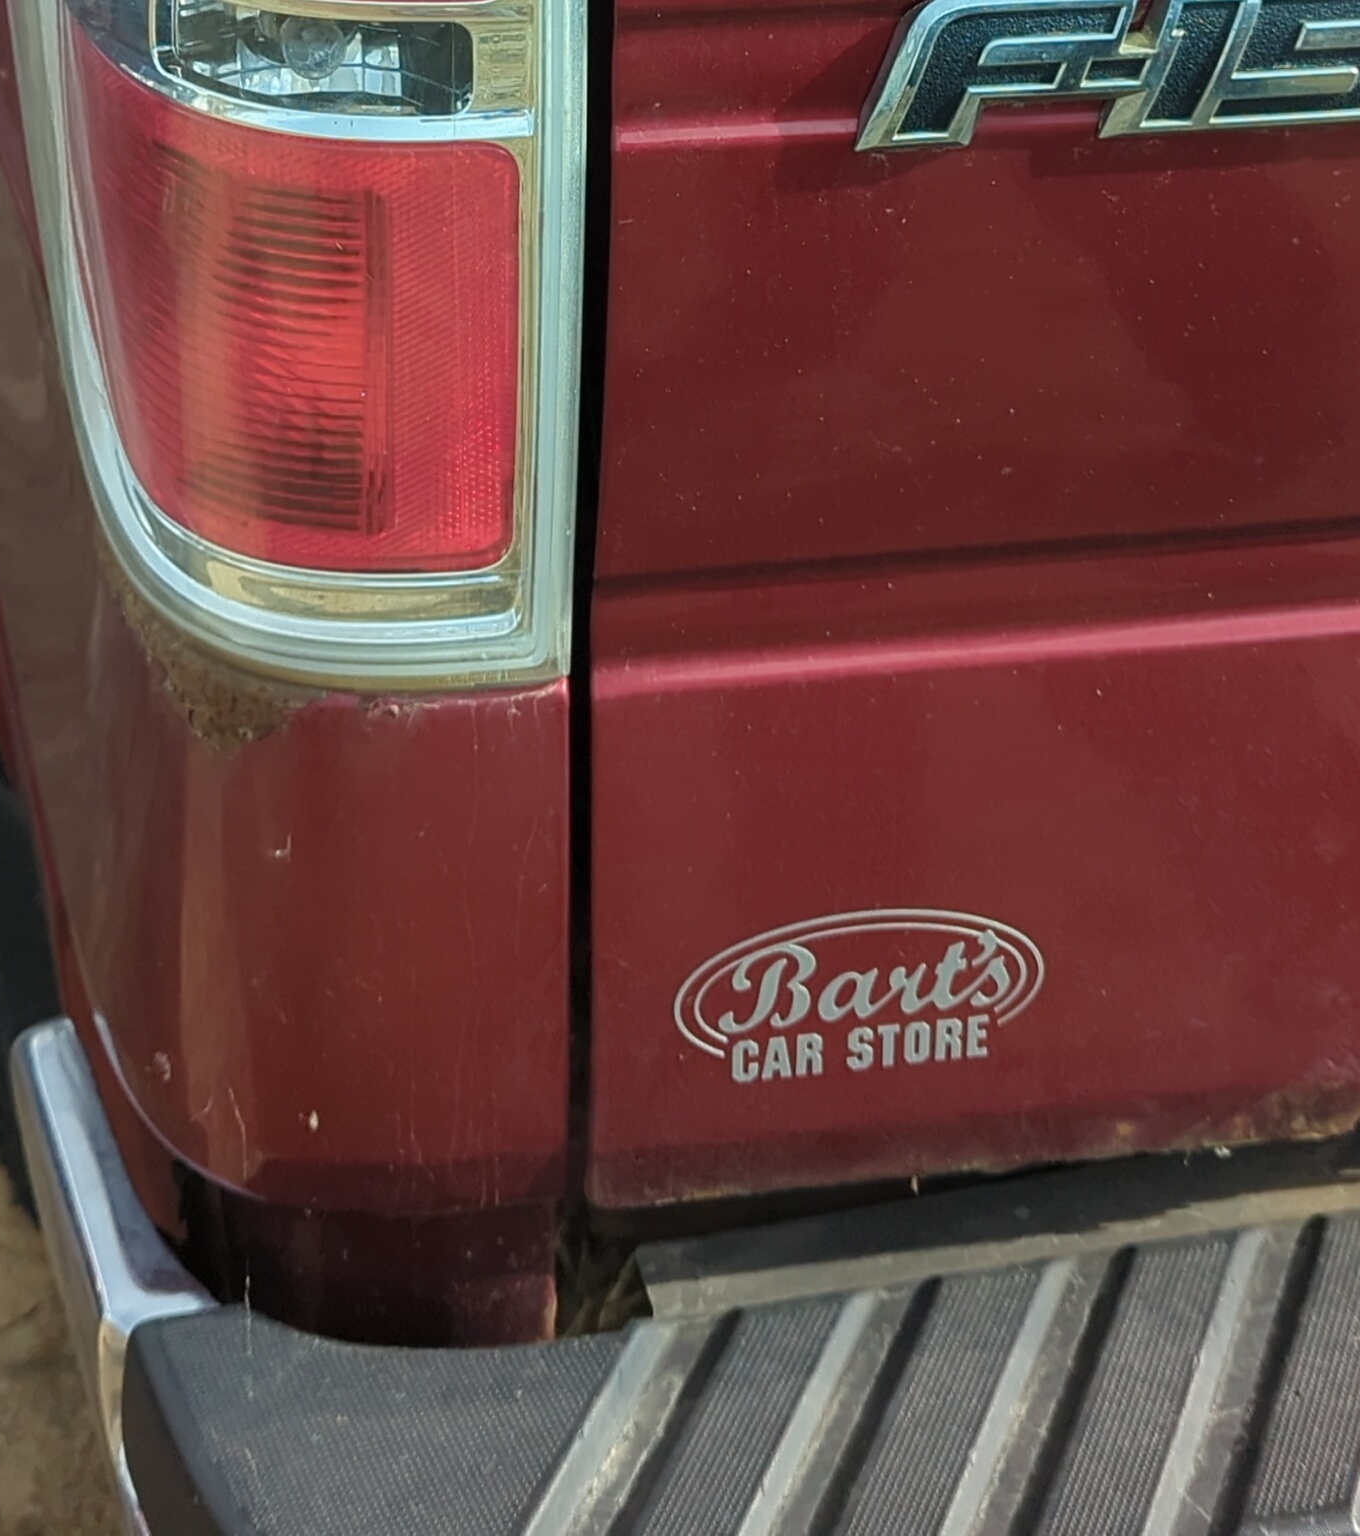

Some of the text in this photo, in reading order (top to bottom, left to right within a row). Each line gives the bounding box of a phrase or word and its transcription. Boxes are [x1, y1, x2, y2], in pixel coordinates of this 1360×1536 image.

[717, 929, 1012, 1033] Bart's
[731, 1014, 990, 1084] CAR STORE
